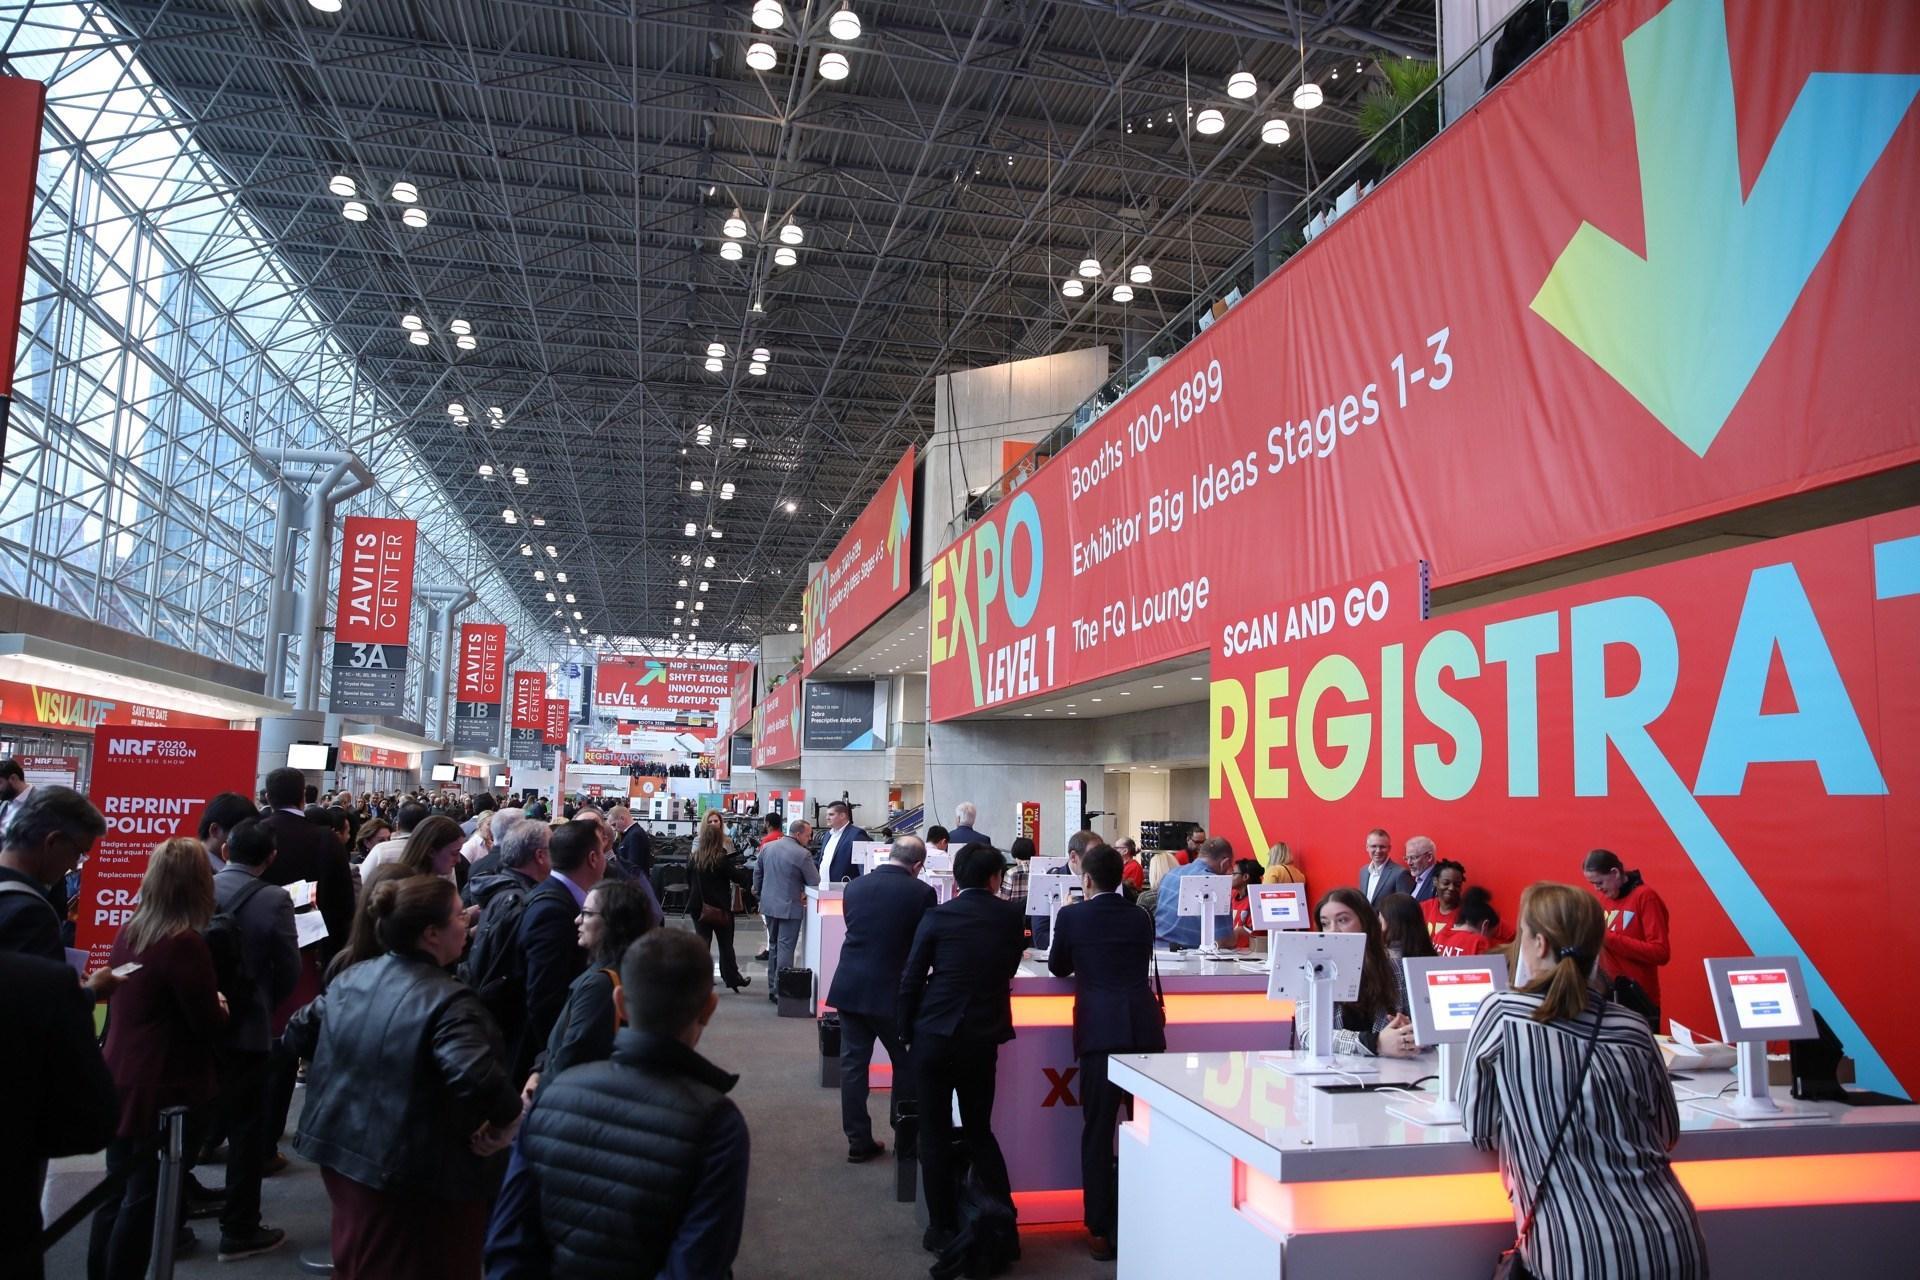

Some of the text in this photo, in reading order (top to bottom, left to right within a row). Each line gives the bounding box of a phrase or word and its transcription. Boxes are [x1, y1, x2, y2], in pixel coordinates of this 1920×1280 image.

[1072, 358, 1224, 500] Booths 100-1899
[1072, 326, 1455, 577] Exhibitor Big Ideas Stages 1-3
[349, 533, 377, 627] JAVITS
[380, 534, 403, 628] CENTER
[931, 490, 1044, 708] EXPO
[1072, 575, 1211, 654] The FQ Lounge
[803, 565, 829, 669] EXPO
[1223, 580, 1390, 658] SCAN AND GO
[349, 642, 389, 669] 3A
[465, 633, 482, 692] JAVITS
[483, 634, 498, 693] CENTER
[986, 625, 1057, 705] LEVEL 1
[598, 682, 649, 706] LEVEL 4
[668, 684, 728, 694] INNOVATION
[669, 673, 729, 684] SHYFT STAGE
[31, 685, 115, 728] VISUALIZE
[132, 704, 168, 721] SAVE THE DATE
[467, 702, 489, 719] 1B
[517, 678, 529, 721] JAVITS
[531, 678, 541, 722] CENTER
[667, 695, 708, 704] STARTUP
[546, 704, 556, 738] JAVITS
[557, 704, 565, 739] CENTER
[34, 757, 52, 765] NRF
[108, 738, 157, 756] NRF
[157, 748, 197, 757] VISION
[158, 740, 187, 749] 2020
[585, 752, 646, 765] REGISTRATION
[105, 797, 205, 815] REPRINT
[105, 817, 182, 835] POLICY
[1024, 807, 1034, 839] CHAR
[96, 889, 143, 906] CRA
